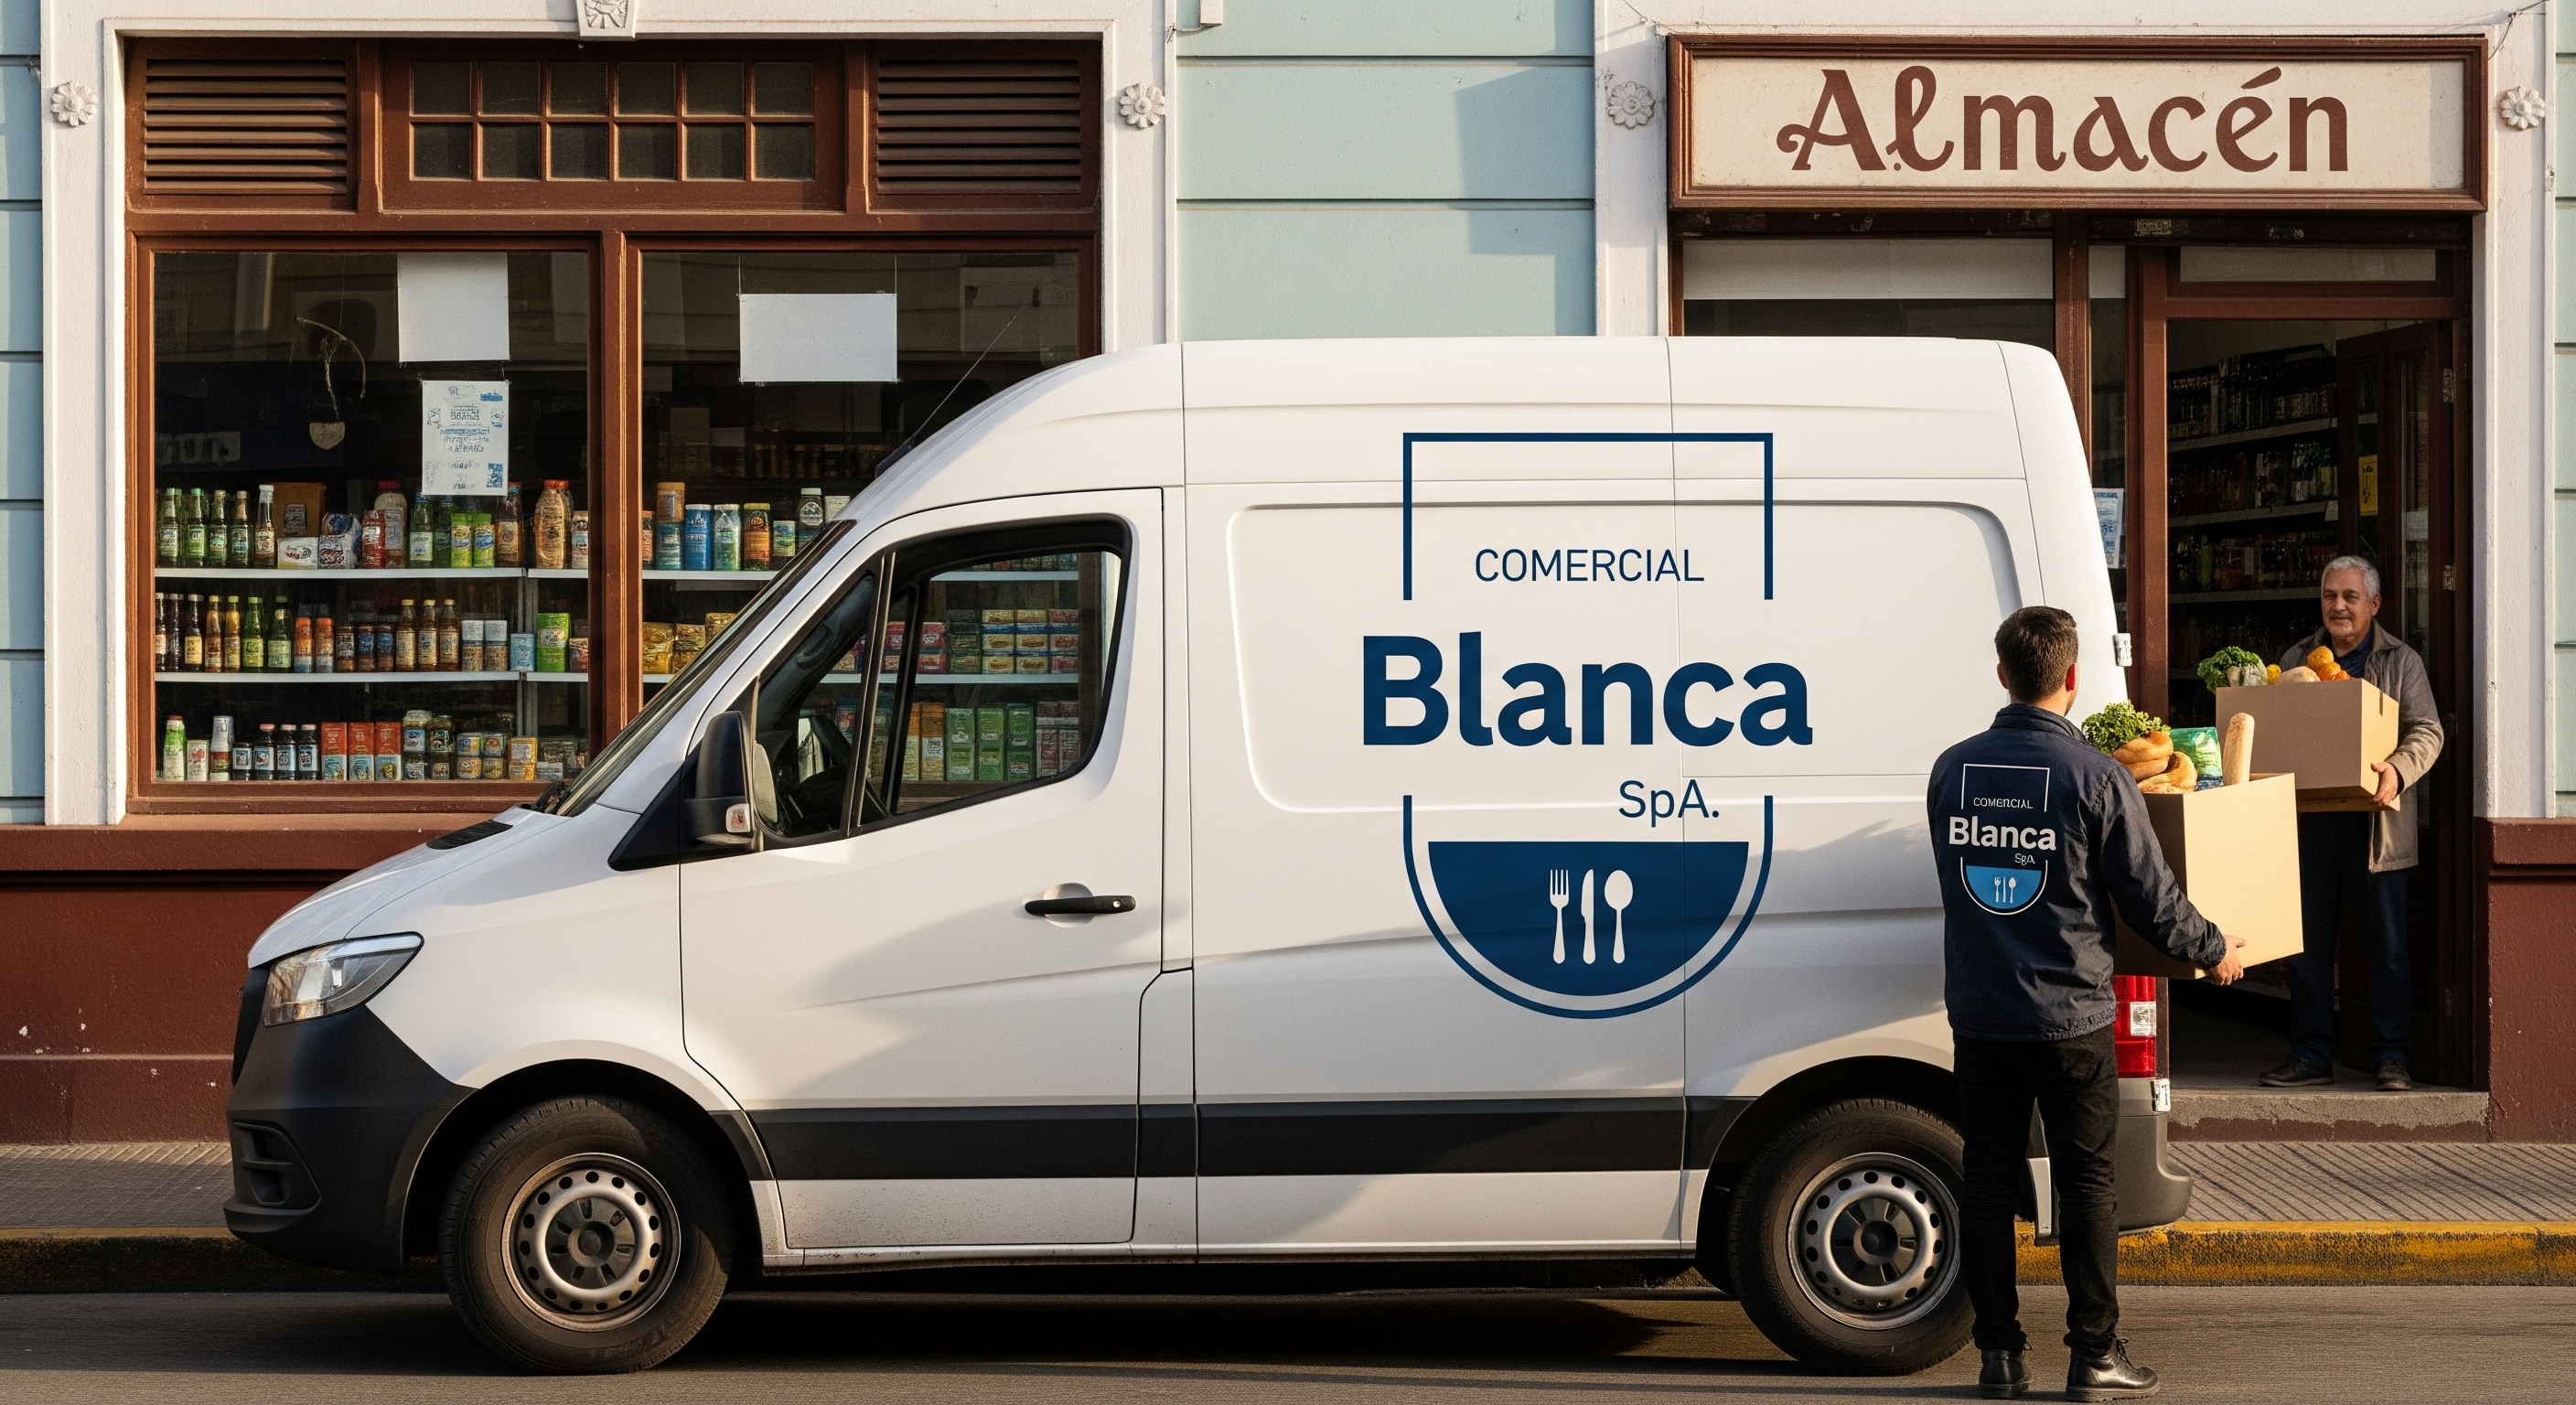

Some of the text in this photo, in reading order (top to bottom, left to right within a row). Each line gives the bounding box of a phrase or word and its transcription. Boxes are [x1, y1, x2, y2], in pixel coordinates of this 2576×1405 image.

[1776, 65, 2349, 173] Almacén
[1475, 548, 1705, 583] COMERCIAL
[1363, 630, 1814, 747] Blanca
[1617, 778, 1720, 829] SpA.
[1973, 797, 2034, 810] COMERCIAL
[1948, 815, 2057, 851] Blanca
